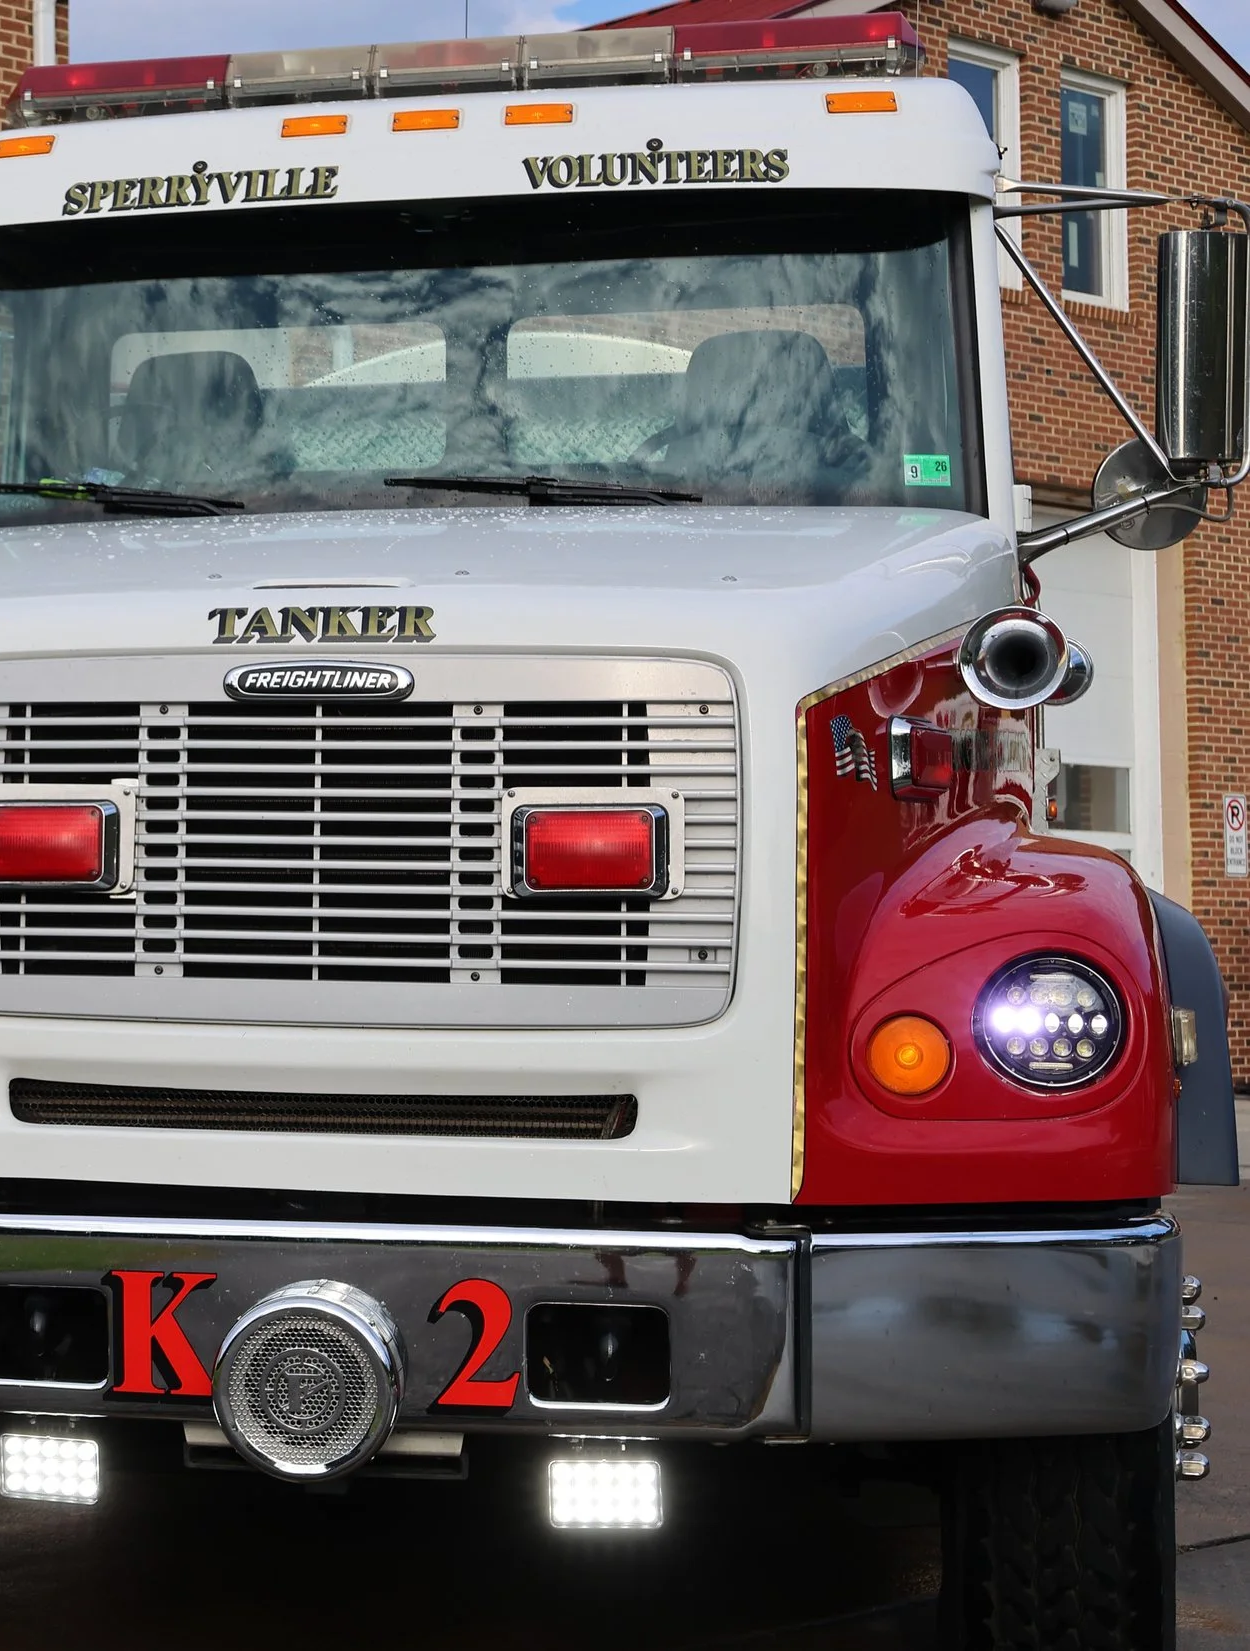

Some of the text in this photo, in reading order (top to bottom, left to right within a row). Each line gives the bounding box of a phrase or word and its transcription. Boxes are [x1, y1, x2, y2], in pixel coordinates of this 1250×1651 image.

[62, 149, 790, 216] SPERRYVILLE VOLUNTEERS
[910, 465, 918, 479] 9
[935, 461, 947, 472] 26
[208, 605, 437, 644] TANKER
[244, 669, 393, 689] FREIGHTLINER
[103, 1269, 521, 1415] K 2
